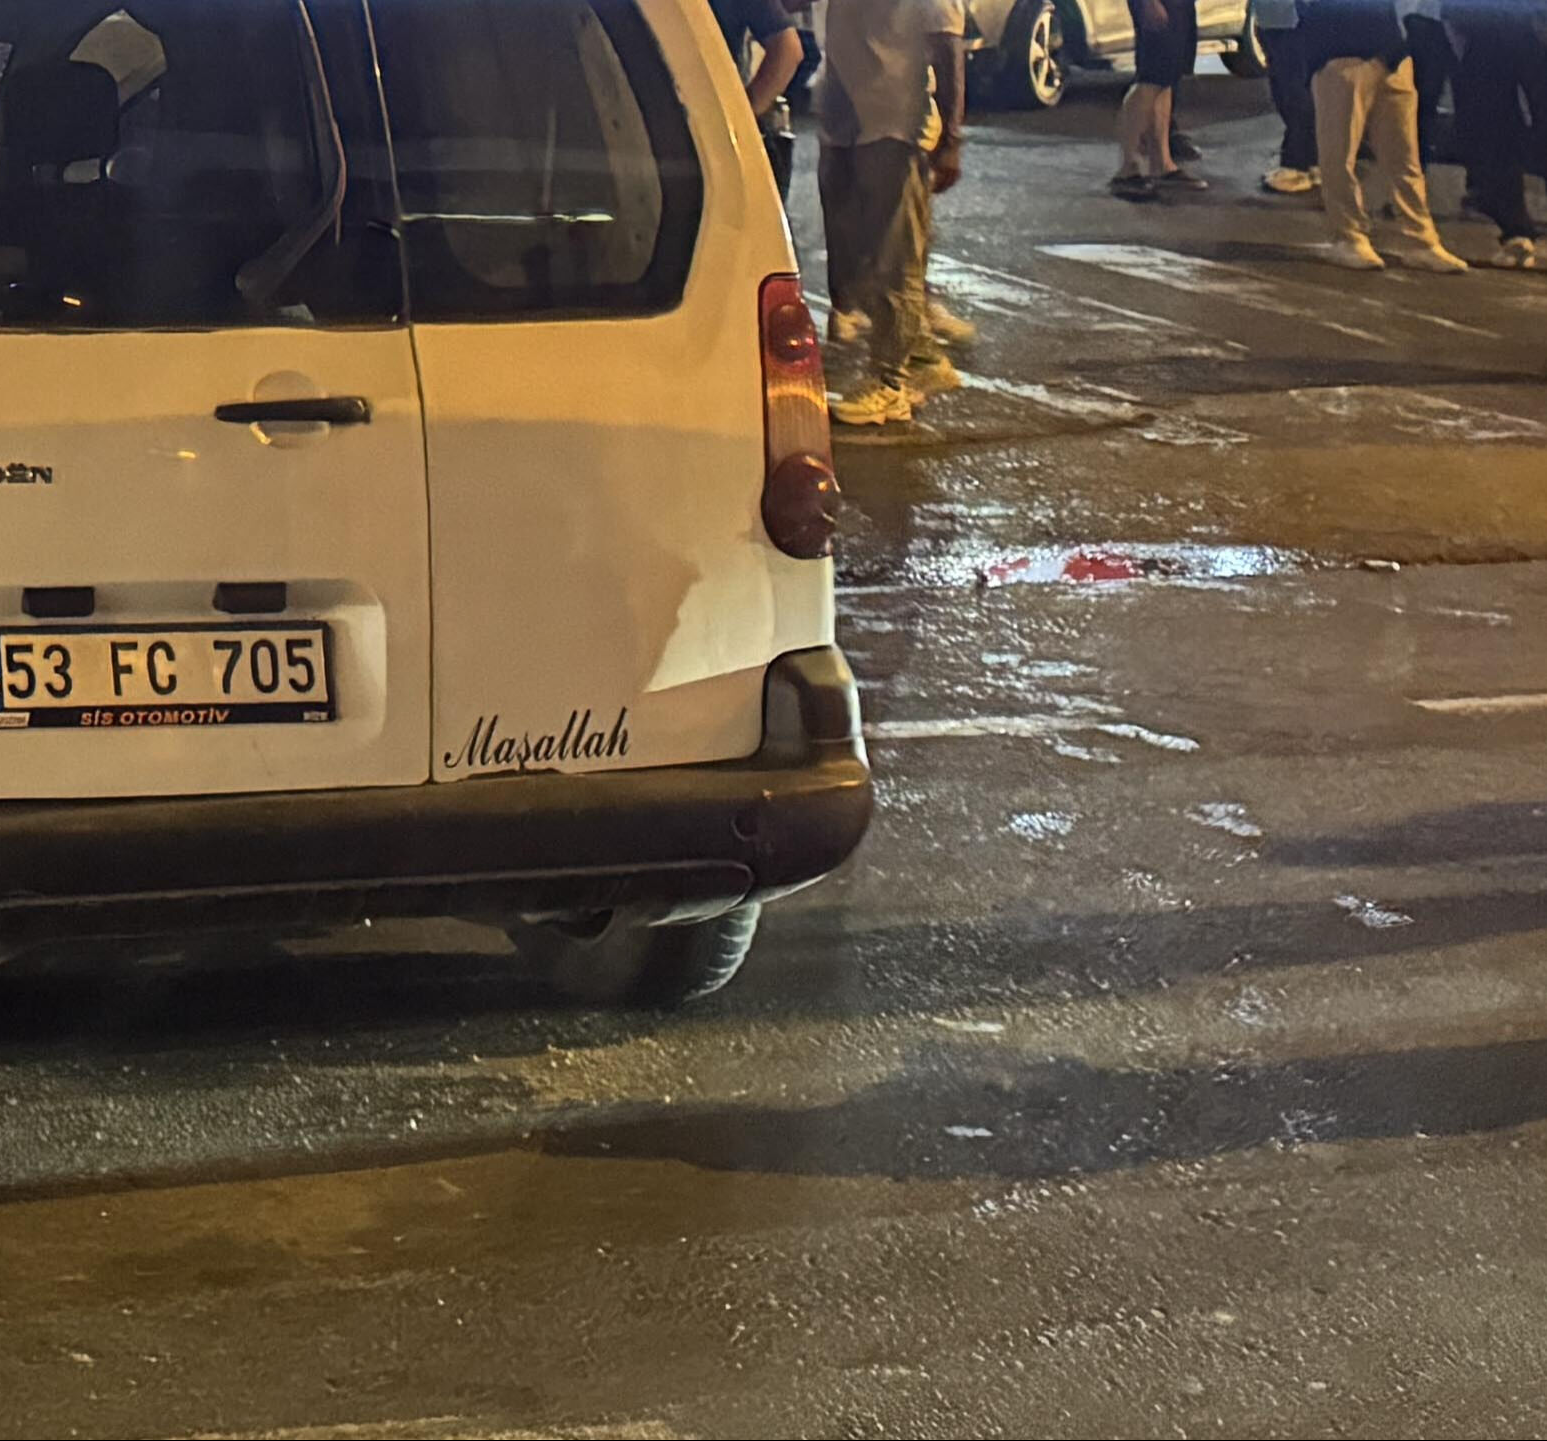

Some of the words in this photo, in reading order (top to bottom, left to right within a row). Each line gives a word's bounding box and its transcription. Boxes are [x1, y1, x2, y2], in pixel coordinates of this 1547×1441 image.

[5, 643, 73, 699] 53
[110, 641, 177, 696] FC
[213, 638, 315, 694] 705
[444, 707, 629, 772] Maşallah
